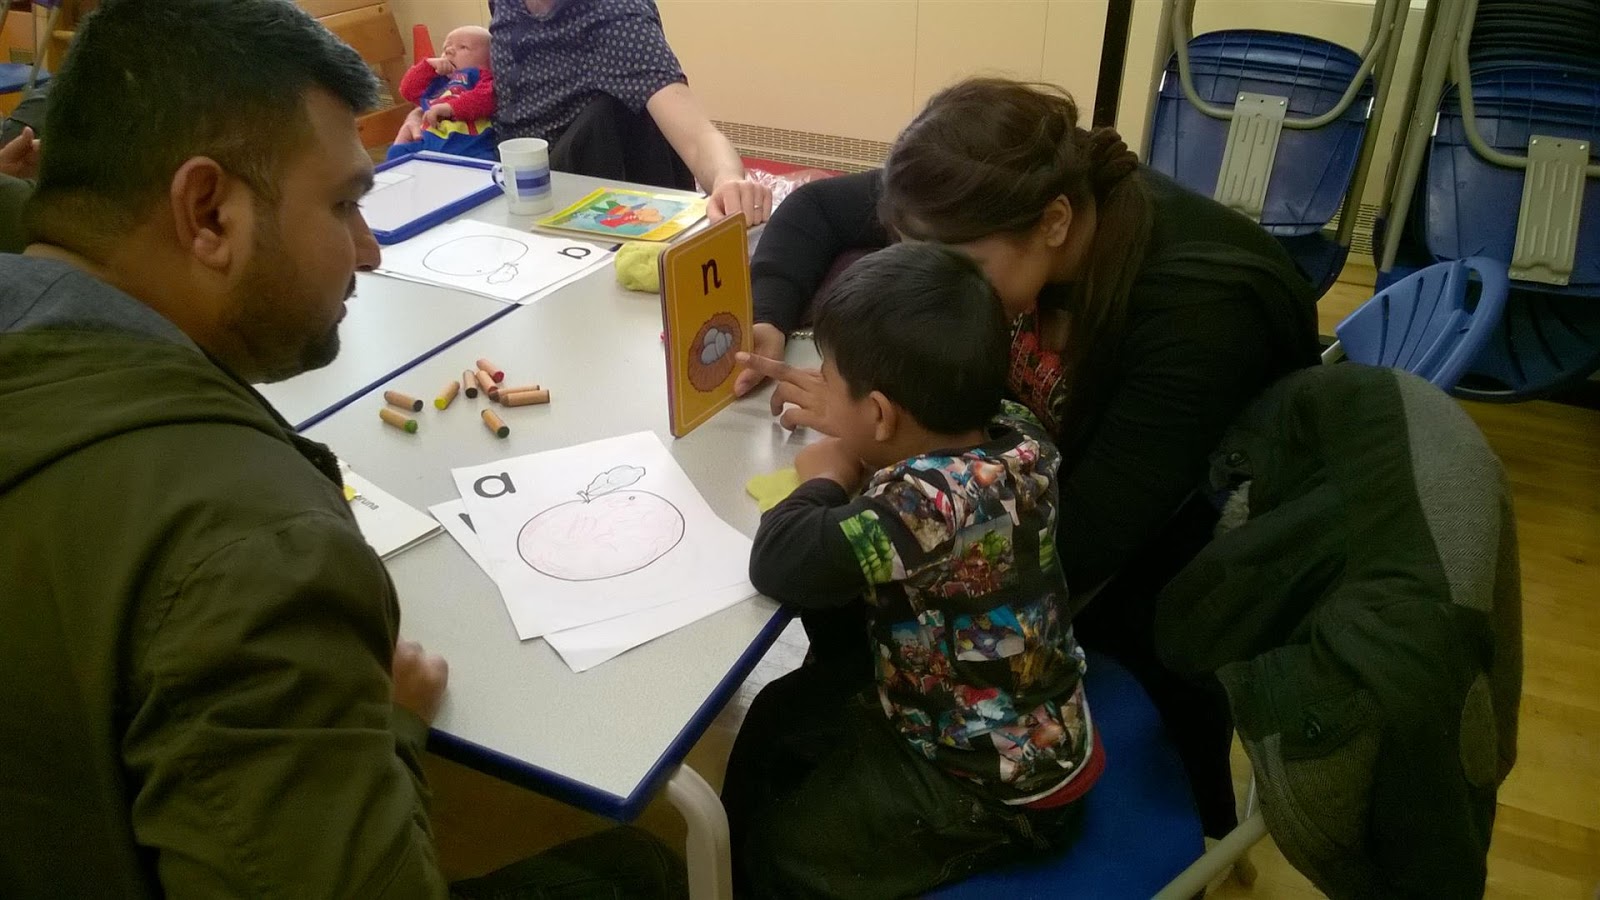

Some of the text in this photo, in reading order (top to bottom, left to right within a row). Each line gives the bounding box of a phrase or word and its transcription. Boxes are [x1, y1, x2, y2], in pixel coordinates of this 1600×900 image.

[557, 246, 592, 260] a
[701, 258, 722, 295] n
[473, 472, 517, 498] a
